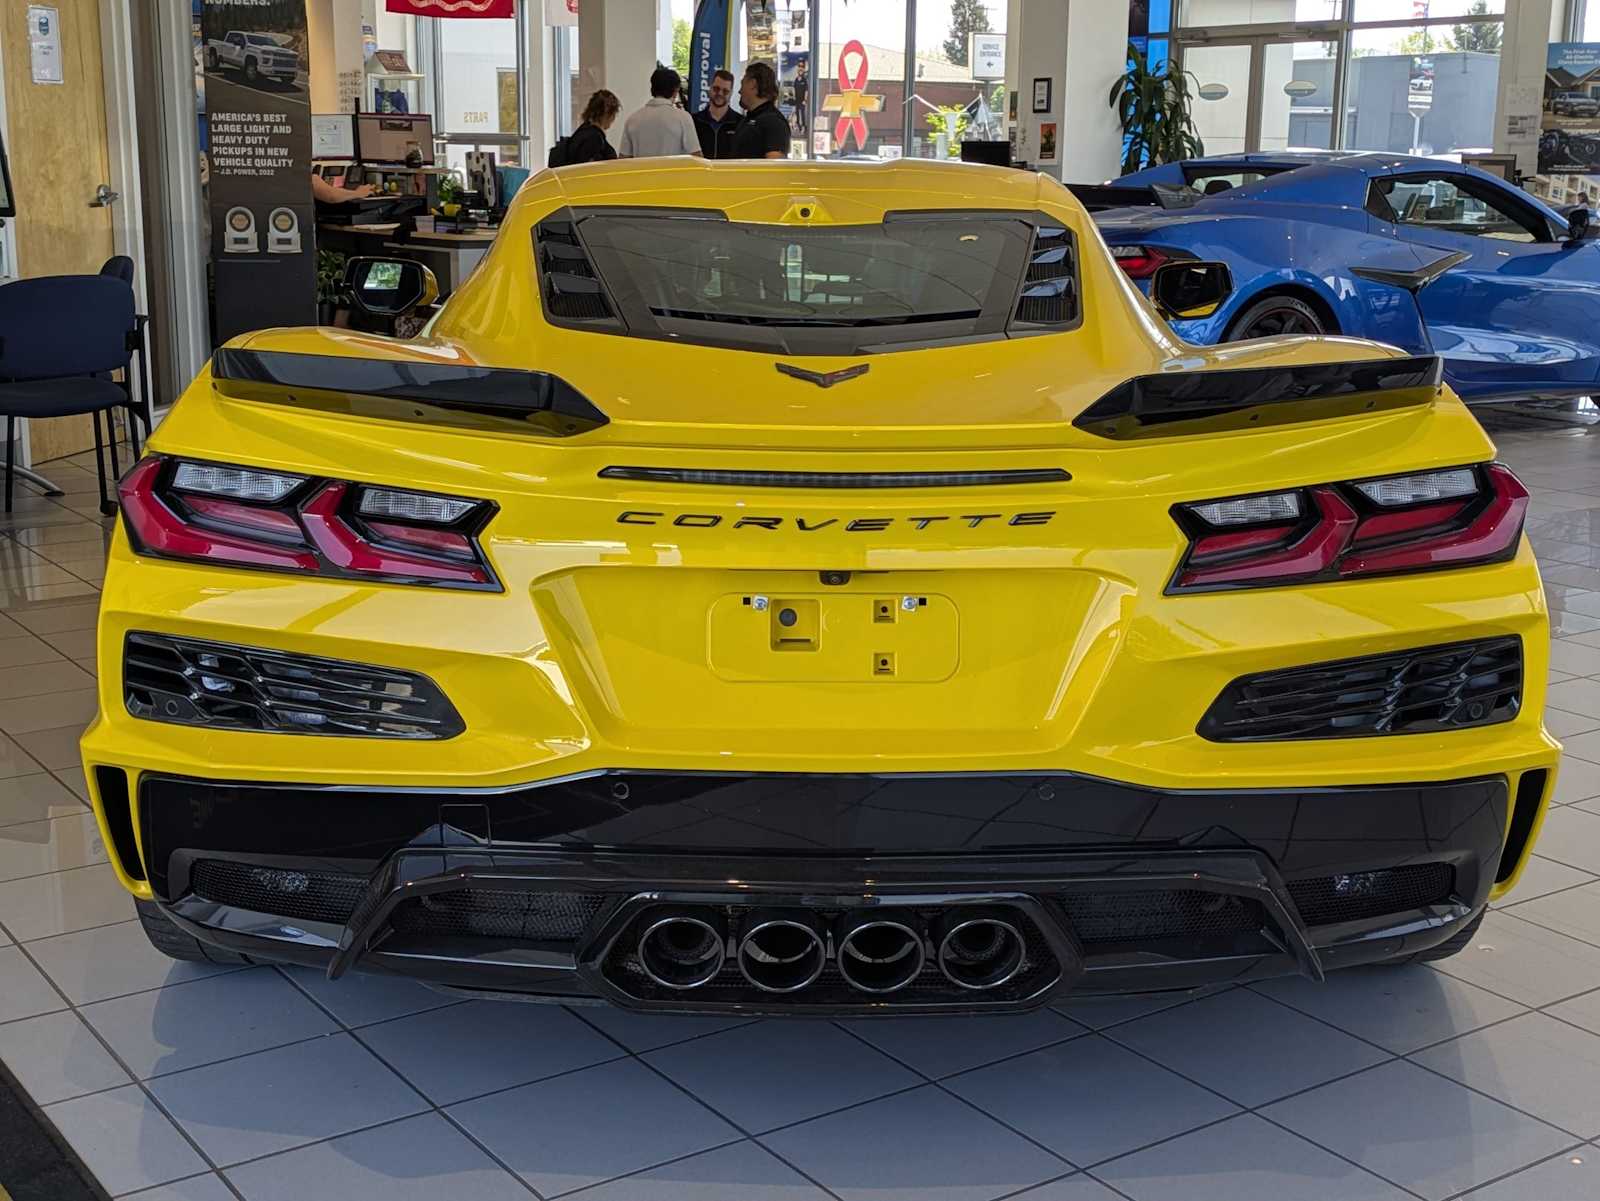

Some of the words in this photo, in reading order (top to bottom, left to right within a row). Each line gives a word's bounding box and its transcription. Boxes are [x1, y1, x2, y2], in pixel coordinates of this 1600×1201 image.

[698, 32, 711, 112] Approval
[211, 112, 261, 122] AMERICA'S
[263, 114, 288, 122] BEST
[211, 124, 242, 133] LARGE
[243, 125, 271, 133] LIGHT
[272, 125, 292, 134] AND
[211, 135, 243, 144] HEAVY
[244, 136, 270, 144] DUTY
[212, 146, 253, 155] PICKUPS
[254, 147, 265, 156] IN
[266, 147, 288, 156] NEW
[213, 157, 253, 167] VEHICLE
[254, 158, 294, 168] QUALITY
[616, 510, 1057, 532] CORVETTE
